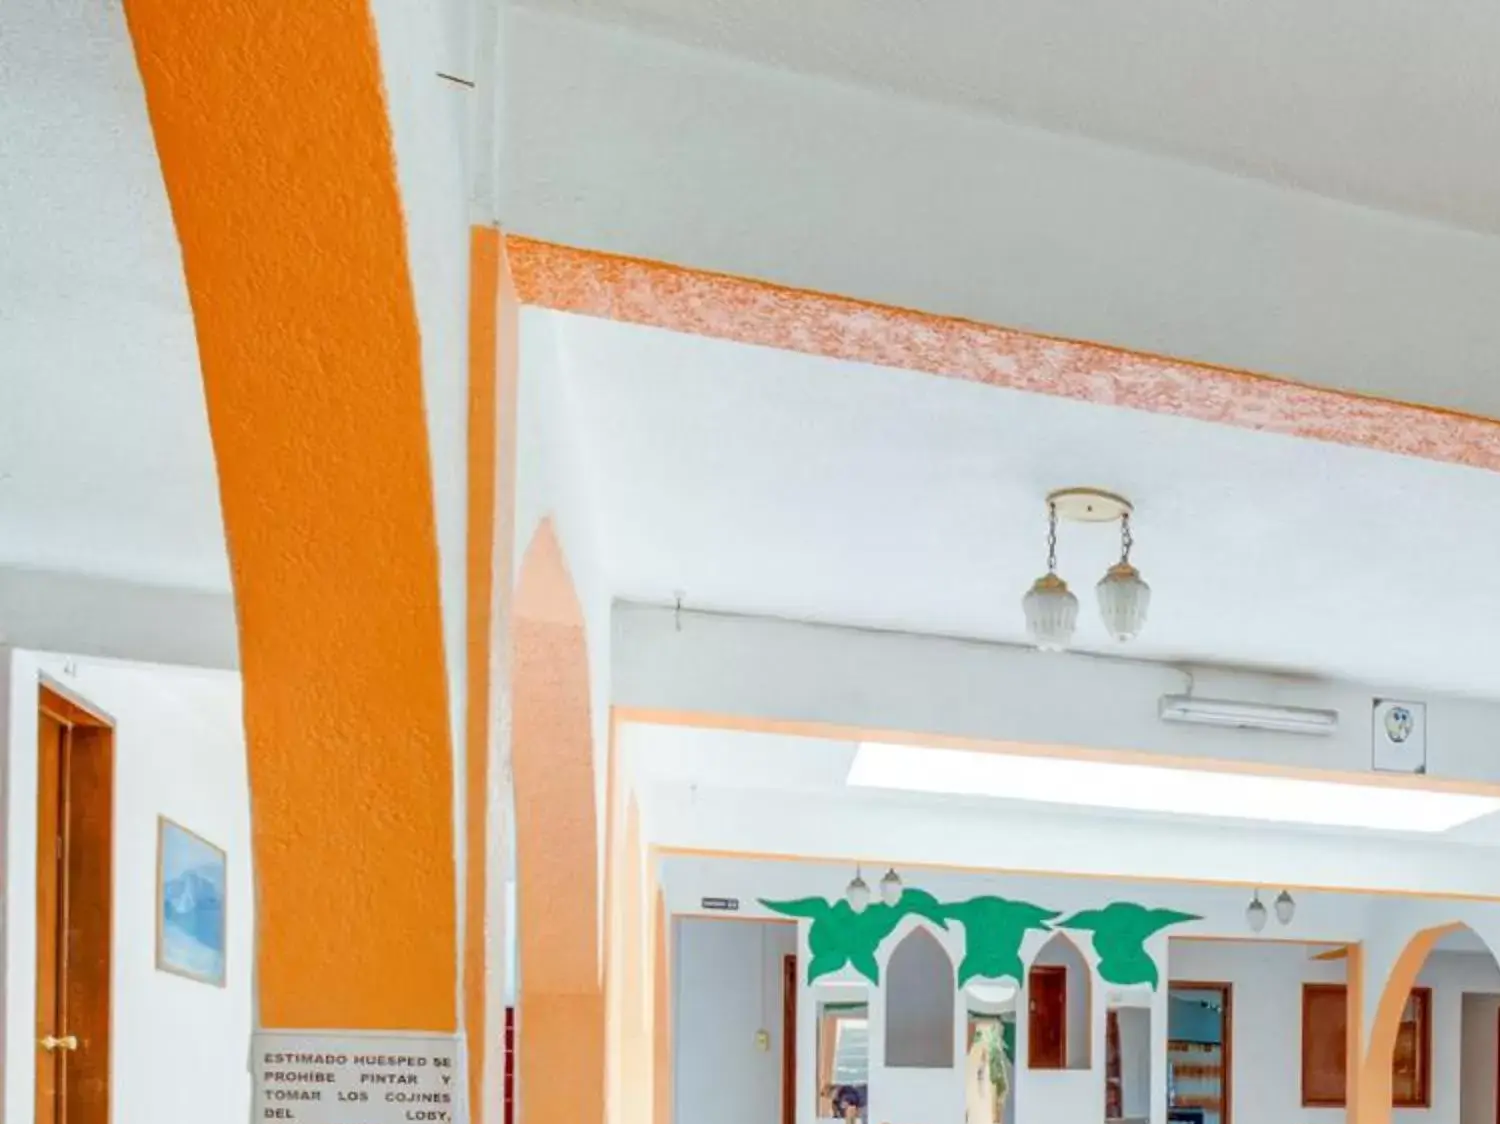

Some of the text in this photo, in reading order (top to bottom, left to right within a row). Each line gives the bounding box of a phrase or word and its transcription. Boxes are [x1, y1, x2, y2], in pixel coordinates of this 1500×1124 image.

[264, 1053, 451, 1068] ESTIMADO HUESPED SE
[264, 1070, 451, 1085] PROHIBE PINTAR Y
[265, 1090, 452, 1103] TOMAR LOS COJINES
[264, 1107, 452, 1123] DEL LOBY,
